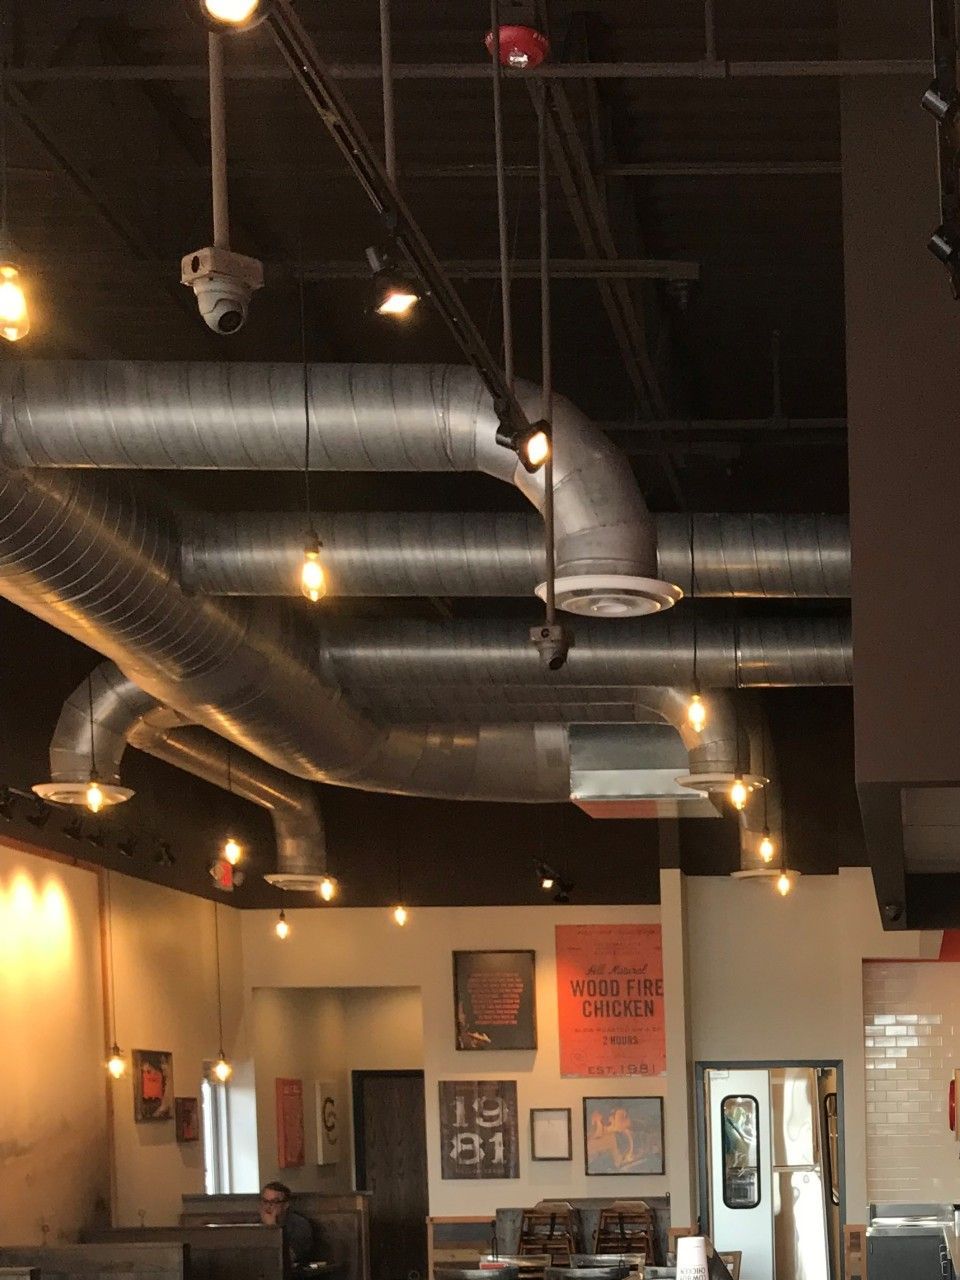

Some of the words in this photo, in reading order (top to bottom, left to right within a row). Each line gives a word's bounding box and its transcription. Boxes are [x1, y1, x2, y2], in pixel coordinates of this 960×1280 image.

[570, 979, 620, 998] WOOD
[626, 979, 664, 997] FIRE
[582, 999, 655, 1018] CHICKEN
[610, 1035, 639, 1046] HOURS
[449, 1095, 509, 1129] 19
[449, 1131, 507, 1165] 81
